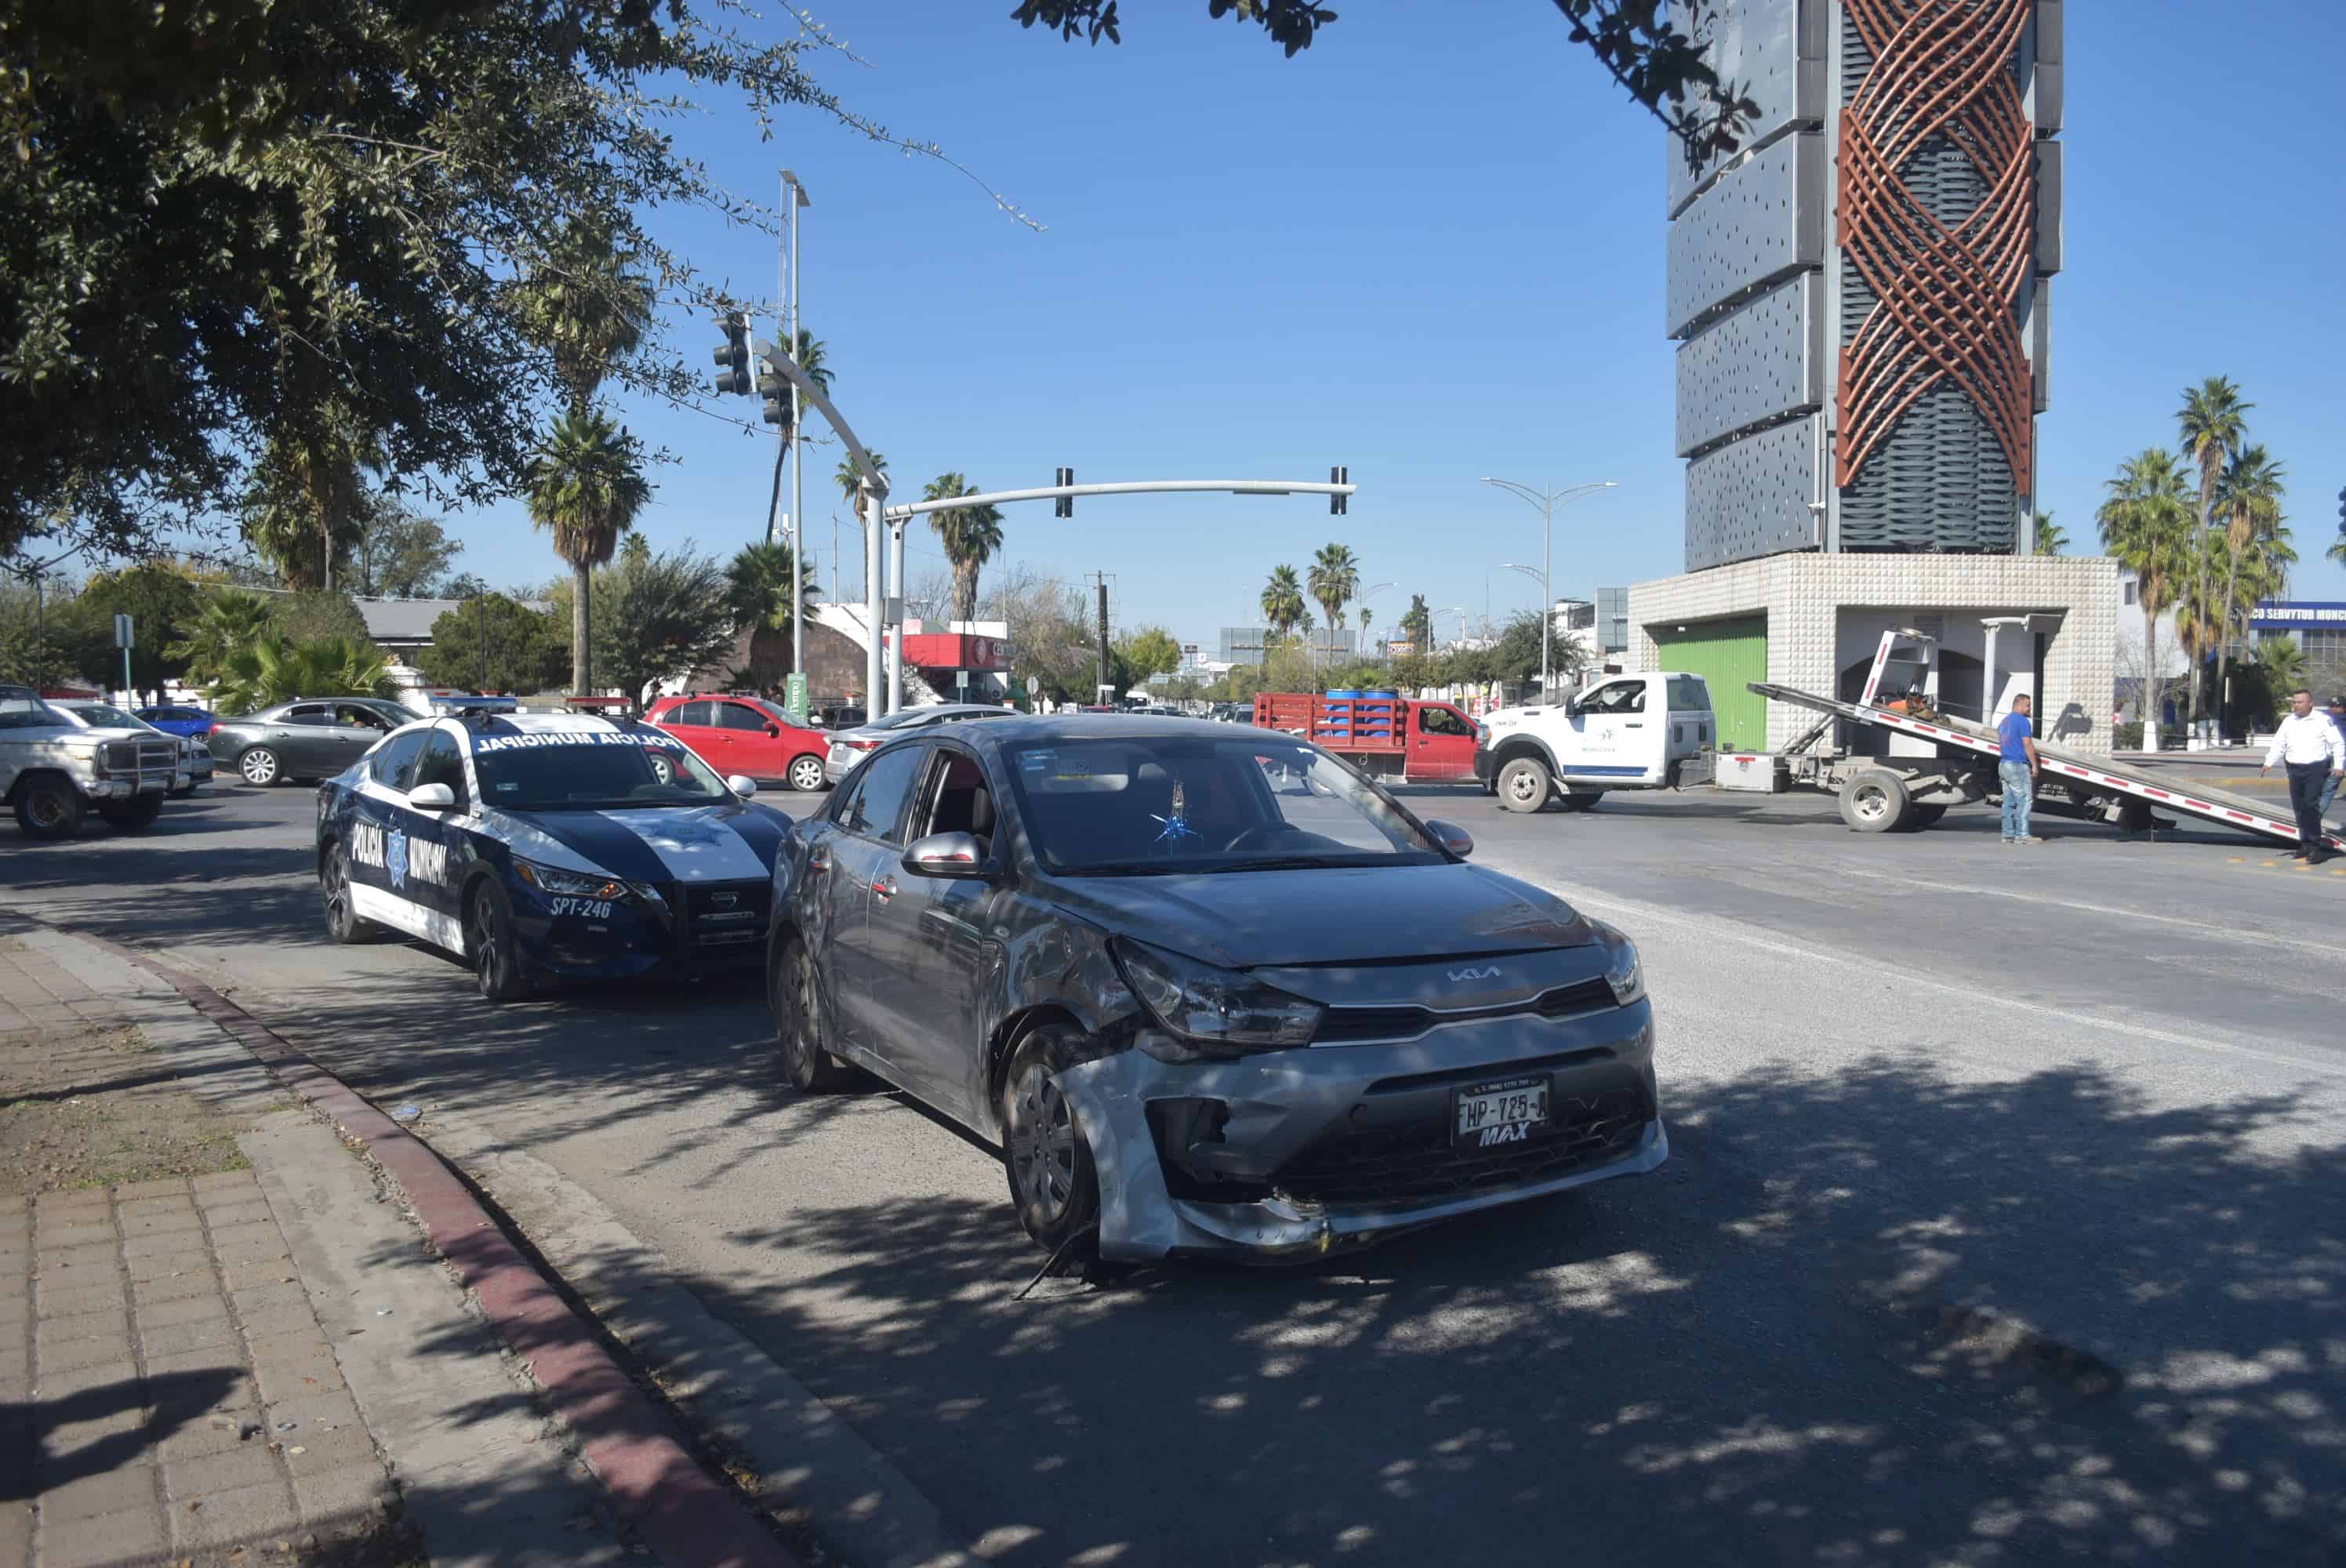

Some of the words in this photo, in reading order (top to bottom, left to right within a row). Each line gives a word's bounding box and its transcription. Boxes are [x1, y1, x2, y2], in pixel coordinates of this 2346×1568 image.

[2267, 608, 2314, 620] SERVYTUR
[2316, 608, 2346, 621] MONC
[352, 822, 383, 869] POLICÍA
[410, 836, 447, 887] MUNICIPAL
[550, 897, 612, 919] SPT-246
[1479, 1121, 1531, 1147] MAX
